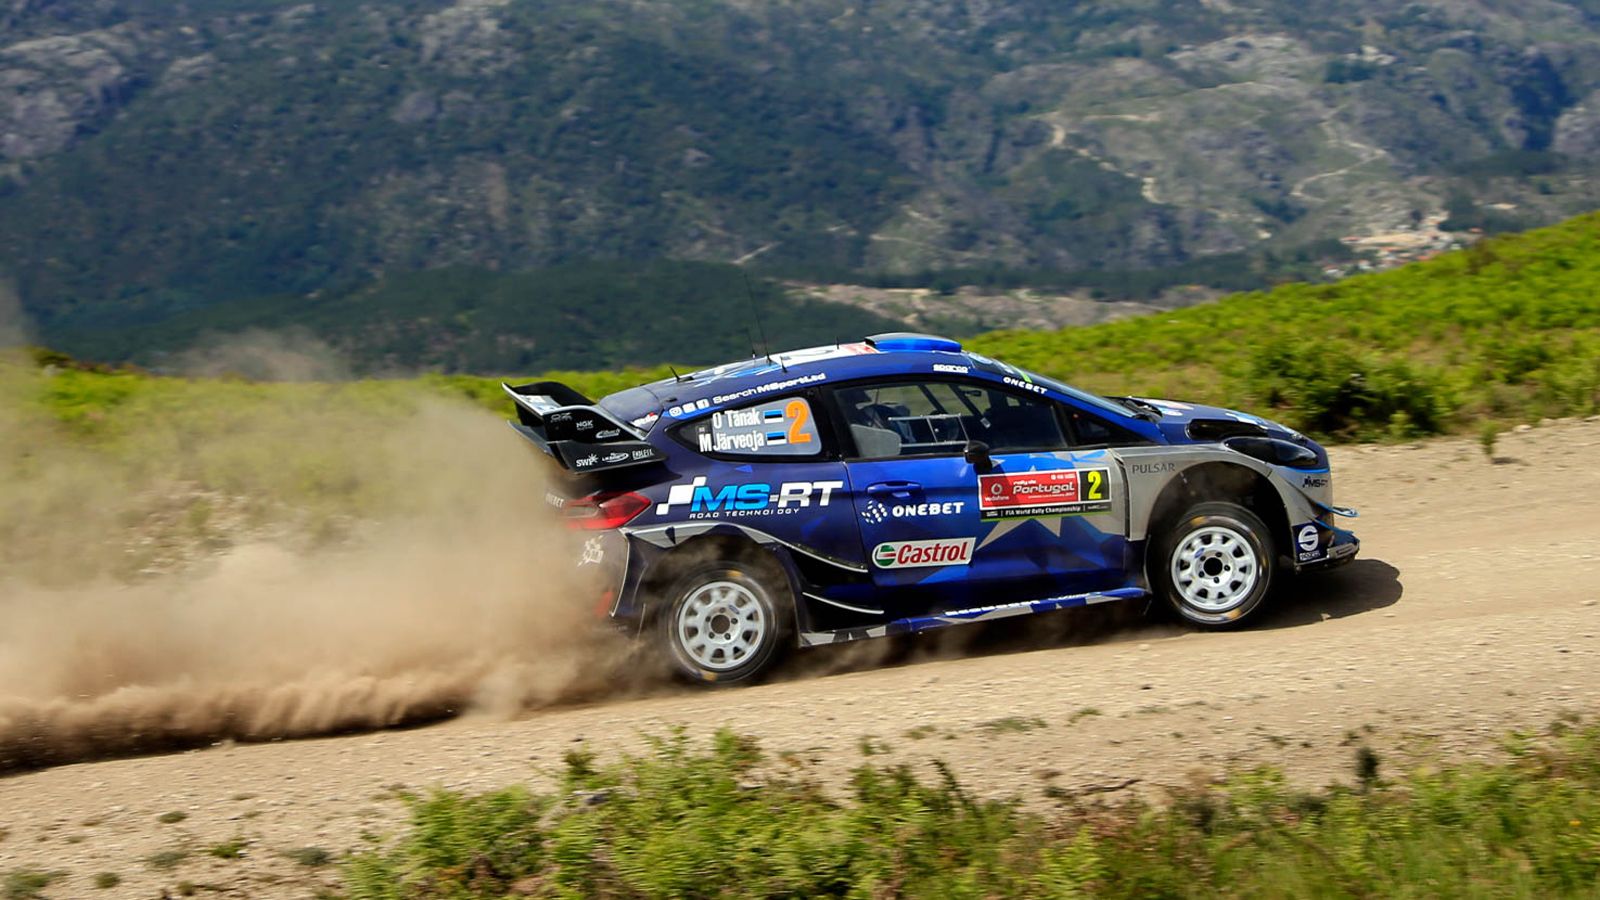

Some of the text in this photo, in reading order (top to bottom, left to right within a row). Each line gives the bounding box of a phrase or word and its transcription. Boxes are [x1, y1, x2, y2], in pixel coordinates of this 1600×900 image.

[1003, 376, 1048, 395] ONEBET
[576, 420, 593, 428] NGK
[712, 408, 761, 429] O Tänak
[785, 400, 812, 444] 2
[699, 430, 765, 452] M Järveoja
[1132, 463, 1176, 475] PULSAR
[1012, 482, 1075, 495] Portugal
[1087, 470, 1102, 500] 2
[691, 481, 844, 512] MS-RT
[892, 502, 965, 517] ONEBET
[897, 541, 968, 565] Castrol
